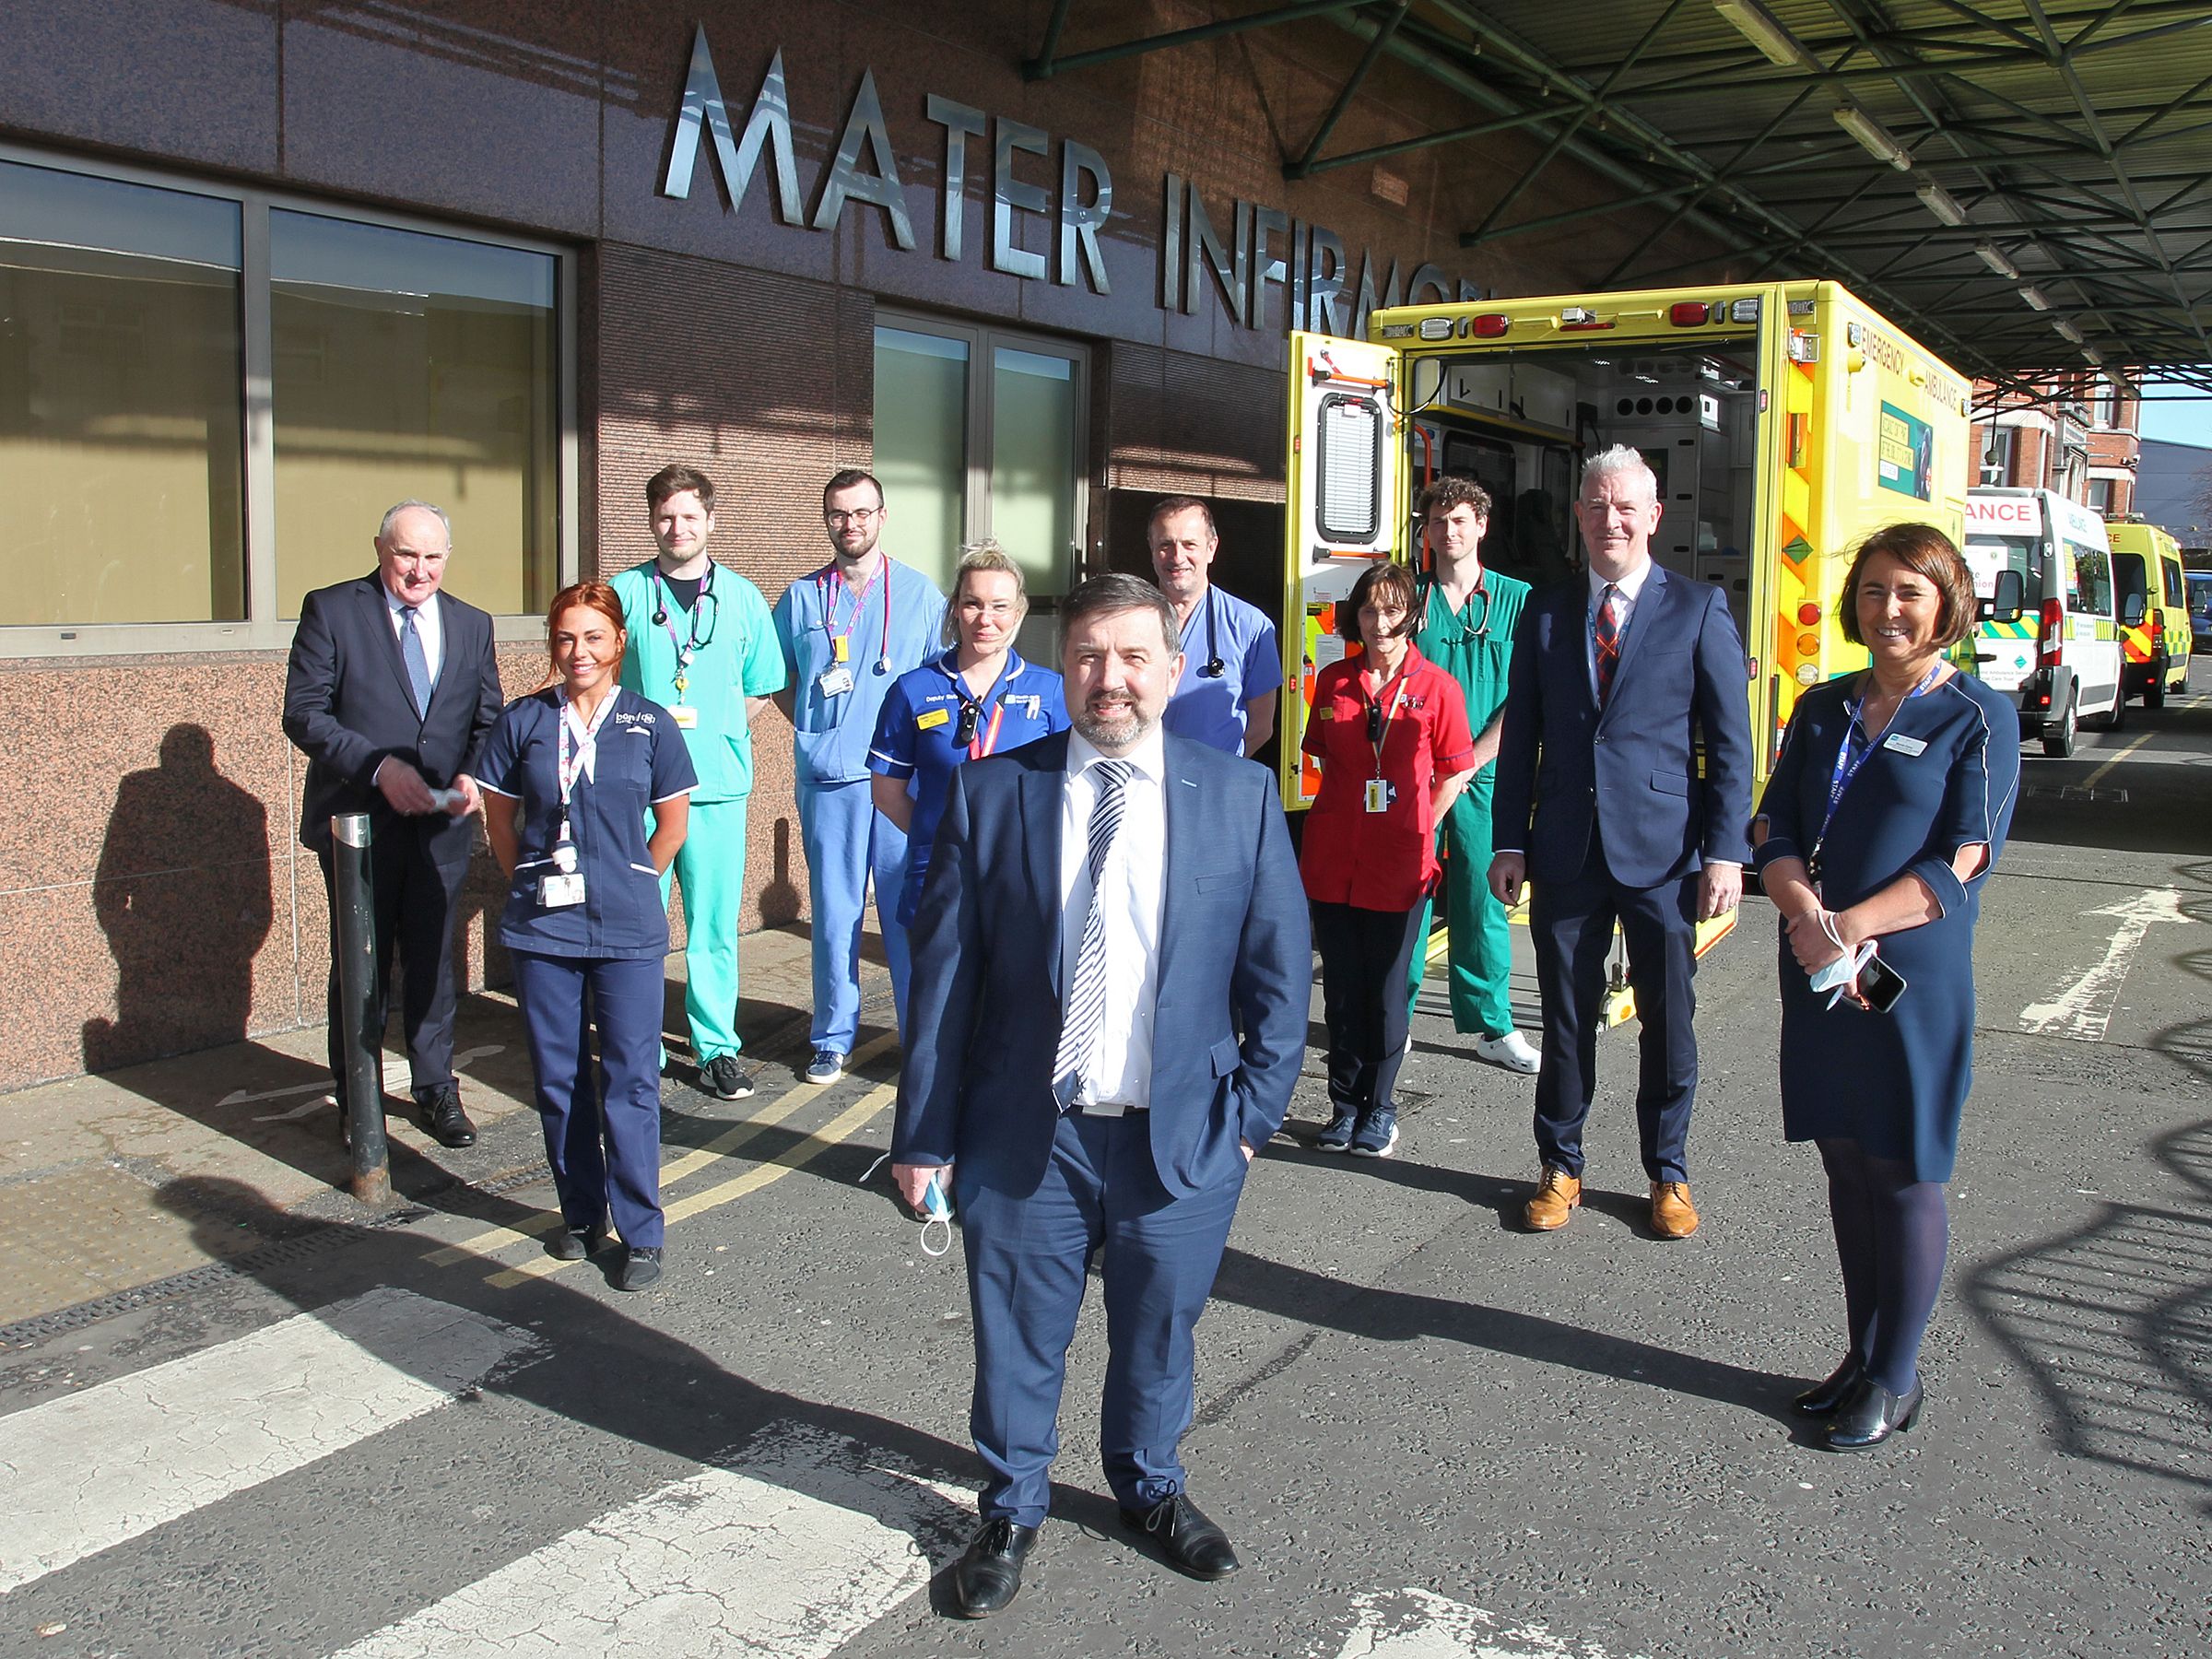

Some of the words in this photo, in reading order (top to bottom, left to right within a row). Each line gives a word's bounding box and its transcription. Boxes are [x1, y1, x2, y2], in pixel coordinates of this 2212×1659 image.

[664, 18, 1112, 296] MATER
[1164, 173, 1497, 342] INFIRM
[1862, 326, 1904, 377] EMERGENCY
[1924, 370, 1957, 411] AMBULANCE
[1965, 503, 2031, 522] ANCE
[1919, 675, 1934, 691] STAFF
[1837, 751, 1847, 771] STAFF
[1847, 759, 1861, 778] STAFF
[1832, 786, 1844, 805] STAFF
